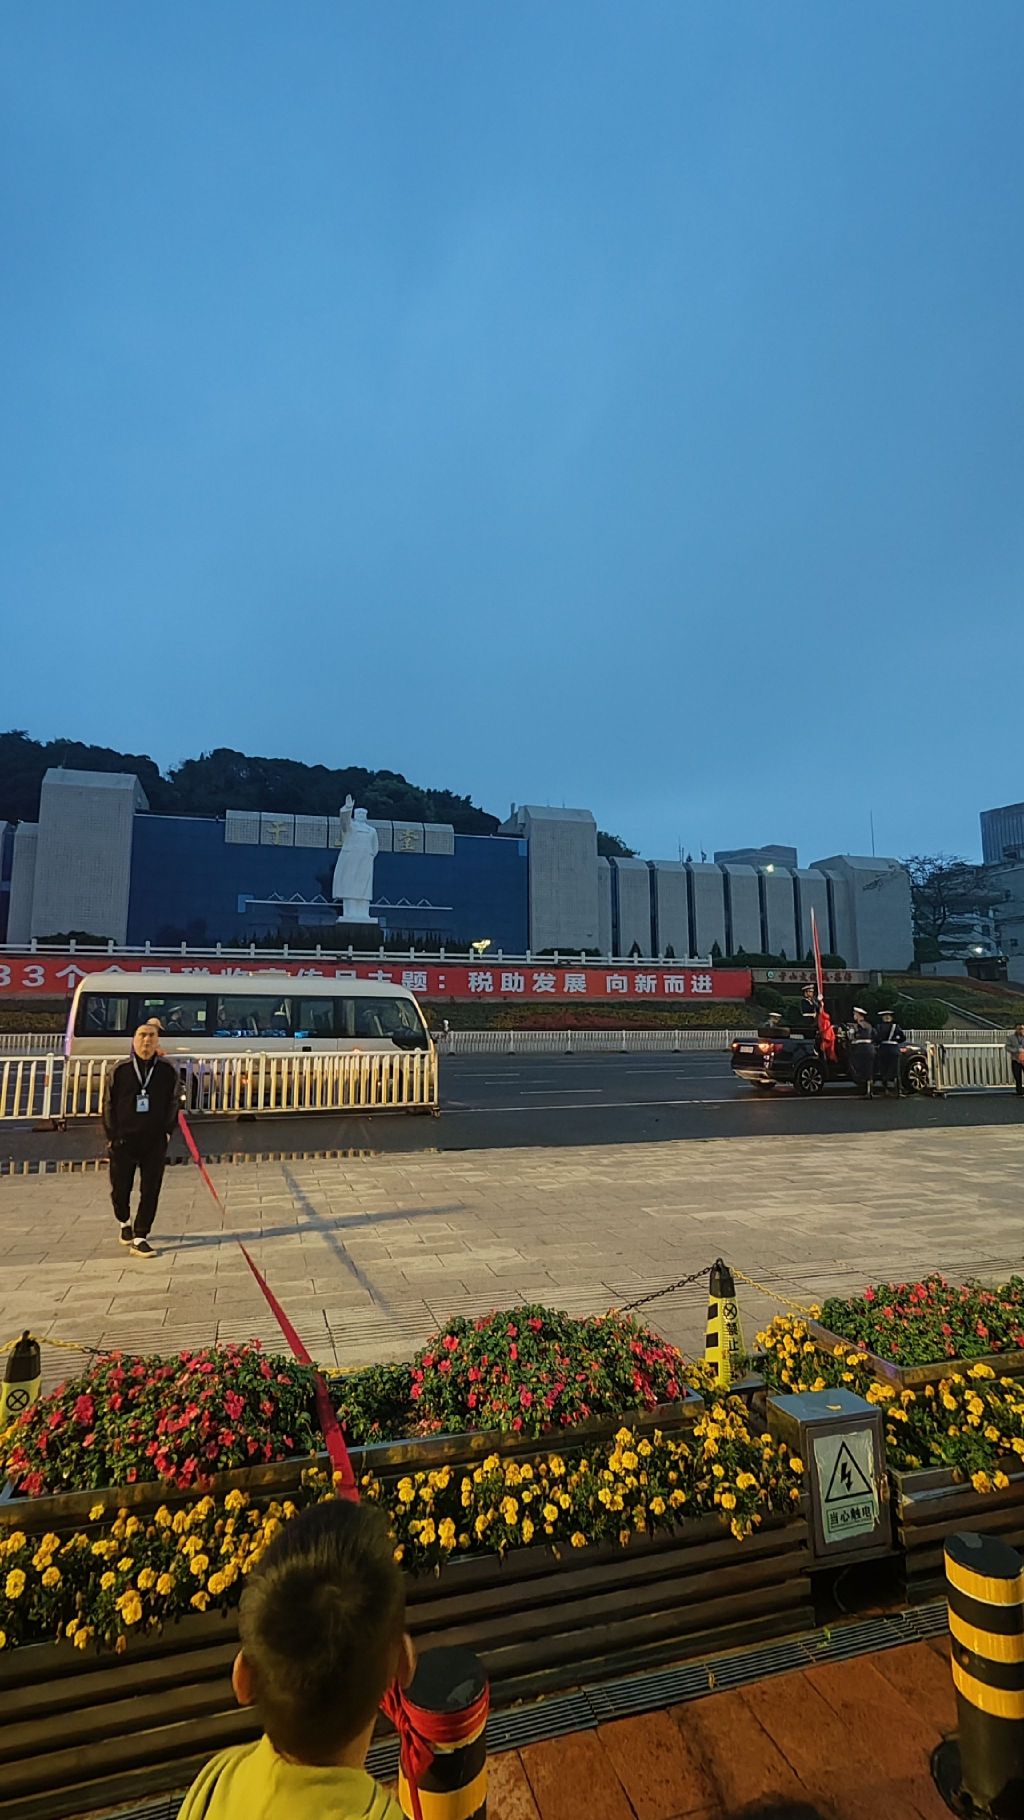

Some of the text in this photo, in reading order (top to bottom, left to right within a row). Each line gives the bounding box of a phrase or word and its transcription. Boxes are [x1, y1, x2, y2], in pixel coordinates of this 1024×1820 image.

[606, 973, 714, 994] 向新而进
[829, 1504, 871, 1524] 当心触电
